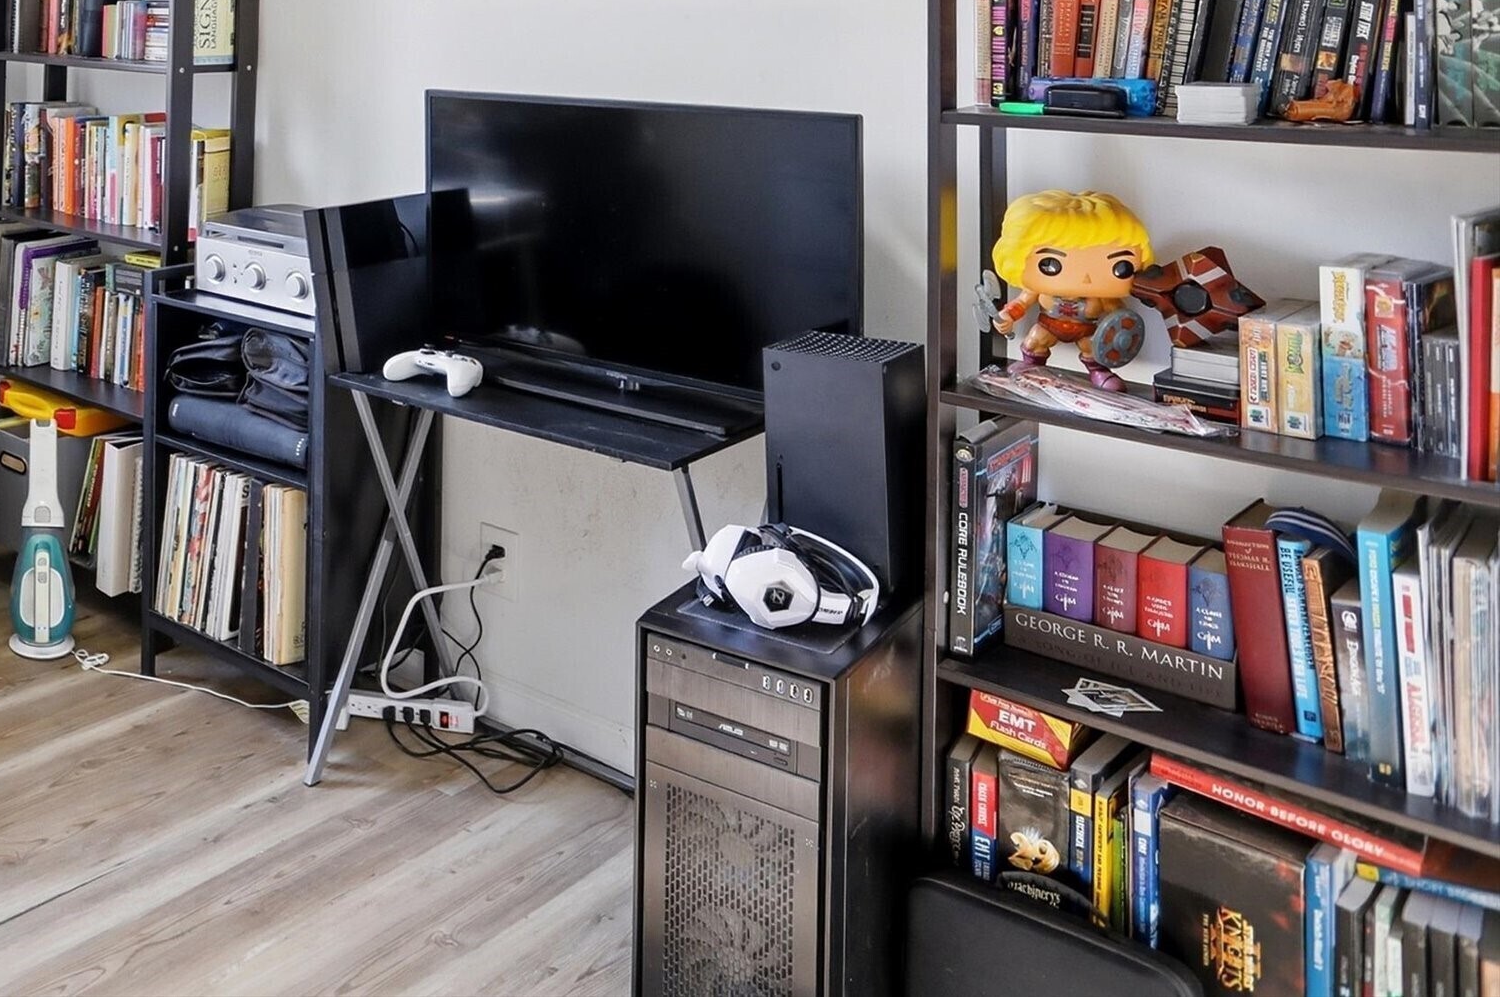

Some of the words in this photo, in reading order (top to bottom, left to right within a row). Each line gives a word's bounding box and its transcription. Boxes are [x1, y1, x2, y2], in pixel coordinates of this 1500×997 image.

[1359, 1, 1375, 22] STAR
[1356, 20, 1372, 40] TREK
[958, 511, 969, 546] CORE
[1280, 546, 1291, 559] BE
[956, 547, 968, 615] RULEBOOK
[1282, 560, 1296, 594] USEFUL
[1014, 612, 1087, 644] GEORGE
[1093, 632, 1110, 651] R.
[1116, 640, 1133, 657] R.
[1140, 646, 1224, 680] MARTIN
[989, 719, 1017, 738] Flash
[1017, 730, 1049, 750] Cards
[998, 709, 1037, 733] EMT
[1211, 783, 1266, 812] HONOR
[1269, 805, 1328, 836] BEFORE
[1330, 827, 1385, 858] GLORY
[974, 835, 991, 861] EMT
